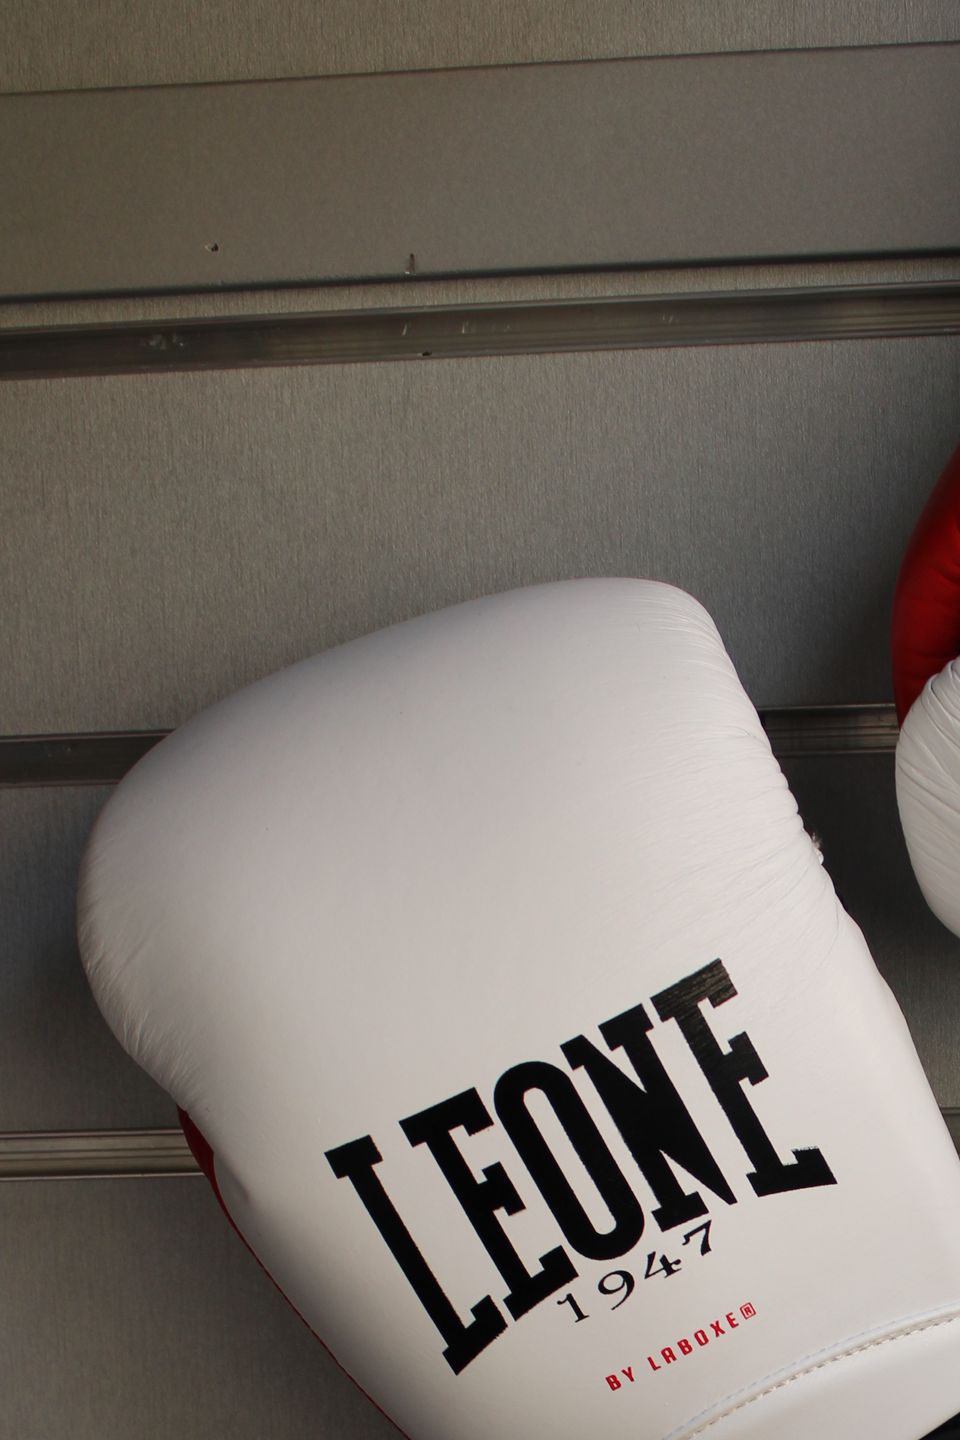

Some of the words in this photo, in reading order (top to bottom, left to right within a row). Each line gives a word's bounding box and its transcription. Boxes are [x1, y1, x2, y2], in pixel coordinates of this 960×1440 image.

[323, 957, 838, 1377] LEONE
[556, 1220, 713, 1324] 1947
[605, 1366, 635, 1391] BY
